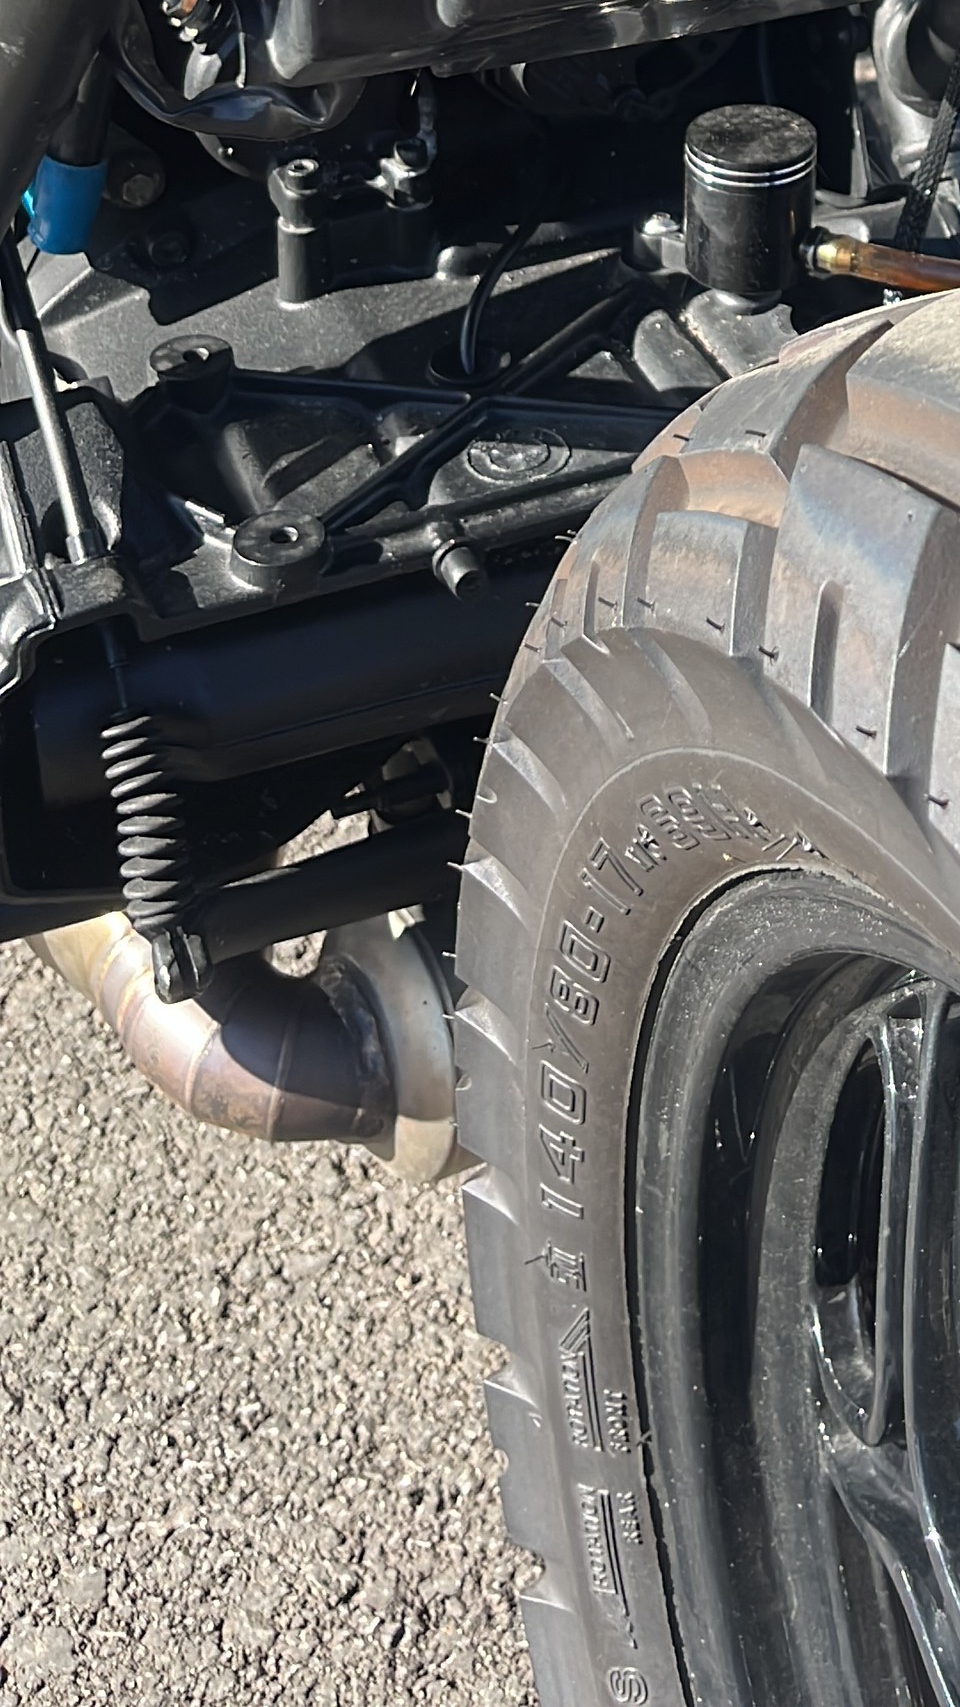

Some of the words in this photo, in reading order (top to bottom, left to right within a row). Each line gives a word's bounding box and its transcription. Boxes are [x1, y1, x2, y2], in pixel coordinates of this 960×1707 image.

[538, 834, 645, 1221] 140/80-17
[560, 1352, 590, 1448] ROTATION
[603, 1388, 631, 1454] FRONT
[577, 1482, 609, 1588] ROTATION
[616, 1491, 644, 1546] REAR
